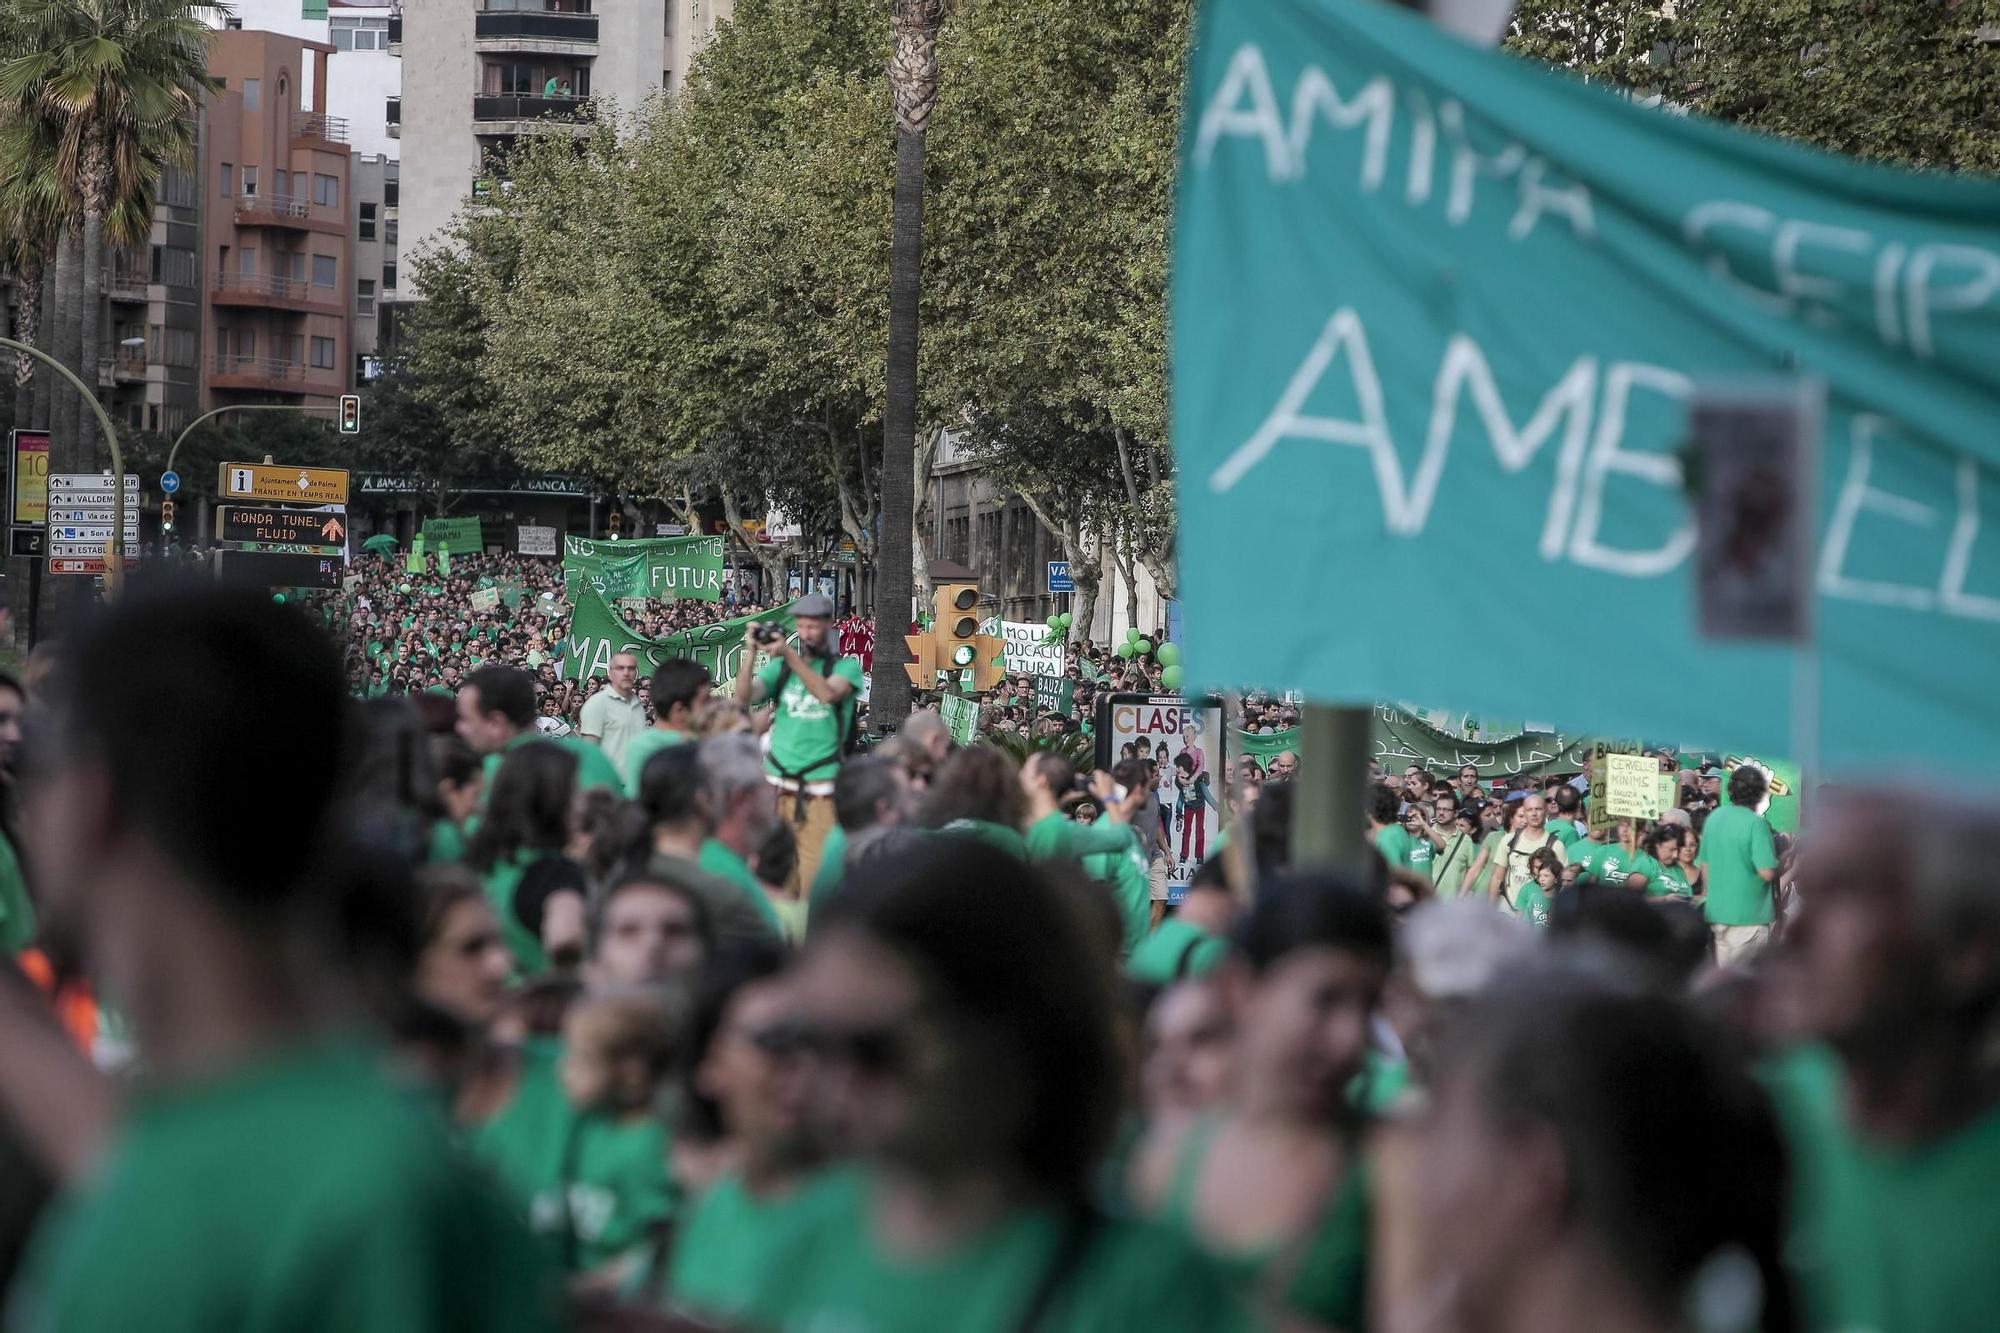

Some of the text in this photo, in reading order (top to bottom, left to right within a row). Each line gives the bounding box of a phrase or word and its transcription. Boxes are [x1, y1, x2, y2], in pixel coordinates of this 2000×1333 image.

[103, 477, 136, 487] SÓER
[260, 476, 298, 486] Ajuntament
[77, 495, 136, 503] VALLDEMSA
[287, 489, 297, 497] EN
[299, 490, 324, 499] TEMPS
[325, 492, 344, 500] REAL
[232, 512, 321, 528] RONDA TUNEL
[256, 527, 297, 540] FLUID
[564, 534, 595, 557] NO
[686, 537, 724, 558] AMB
[1050, 565, 1072, 577] VA
[652, 566, 720, 591] FUTUR
[1113, 706, 1205, 735] CLASES
